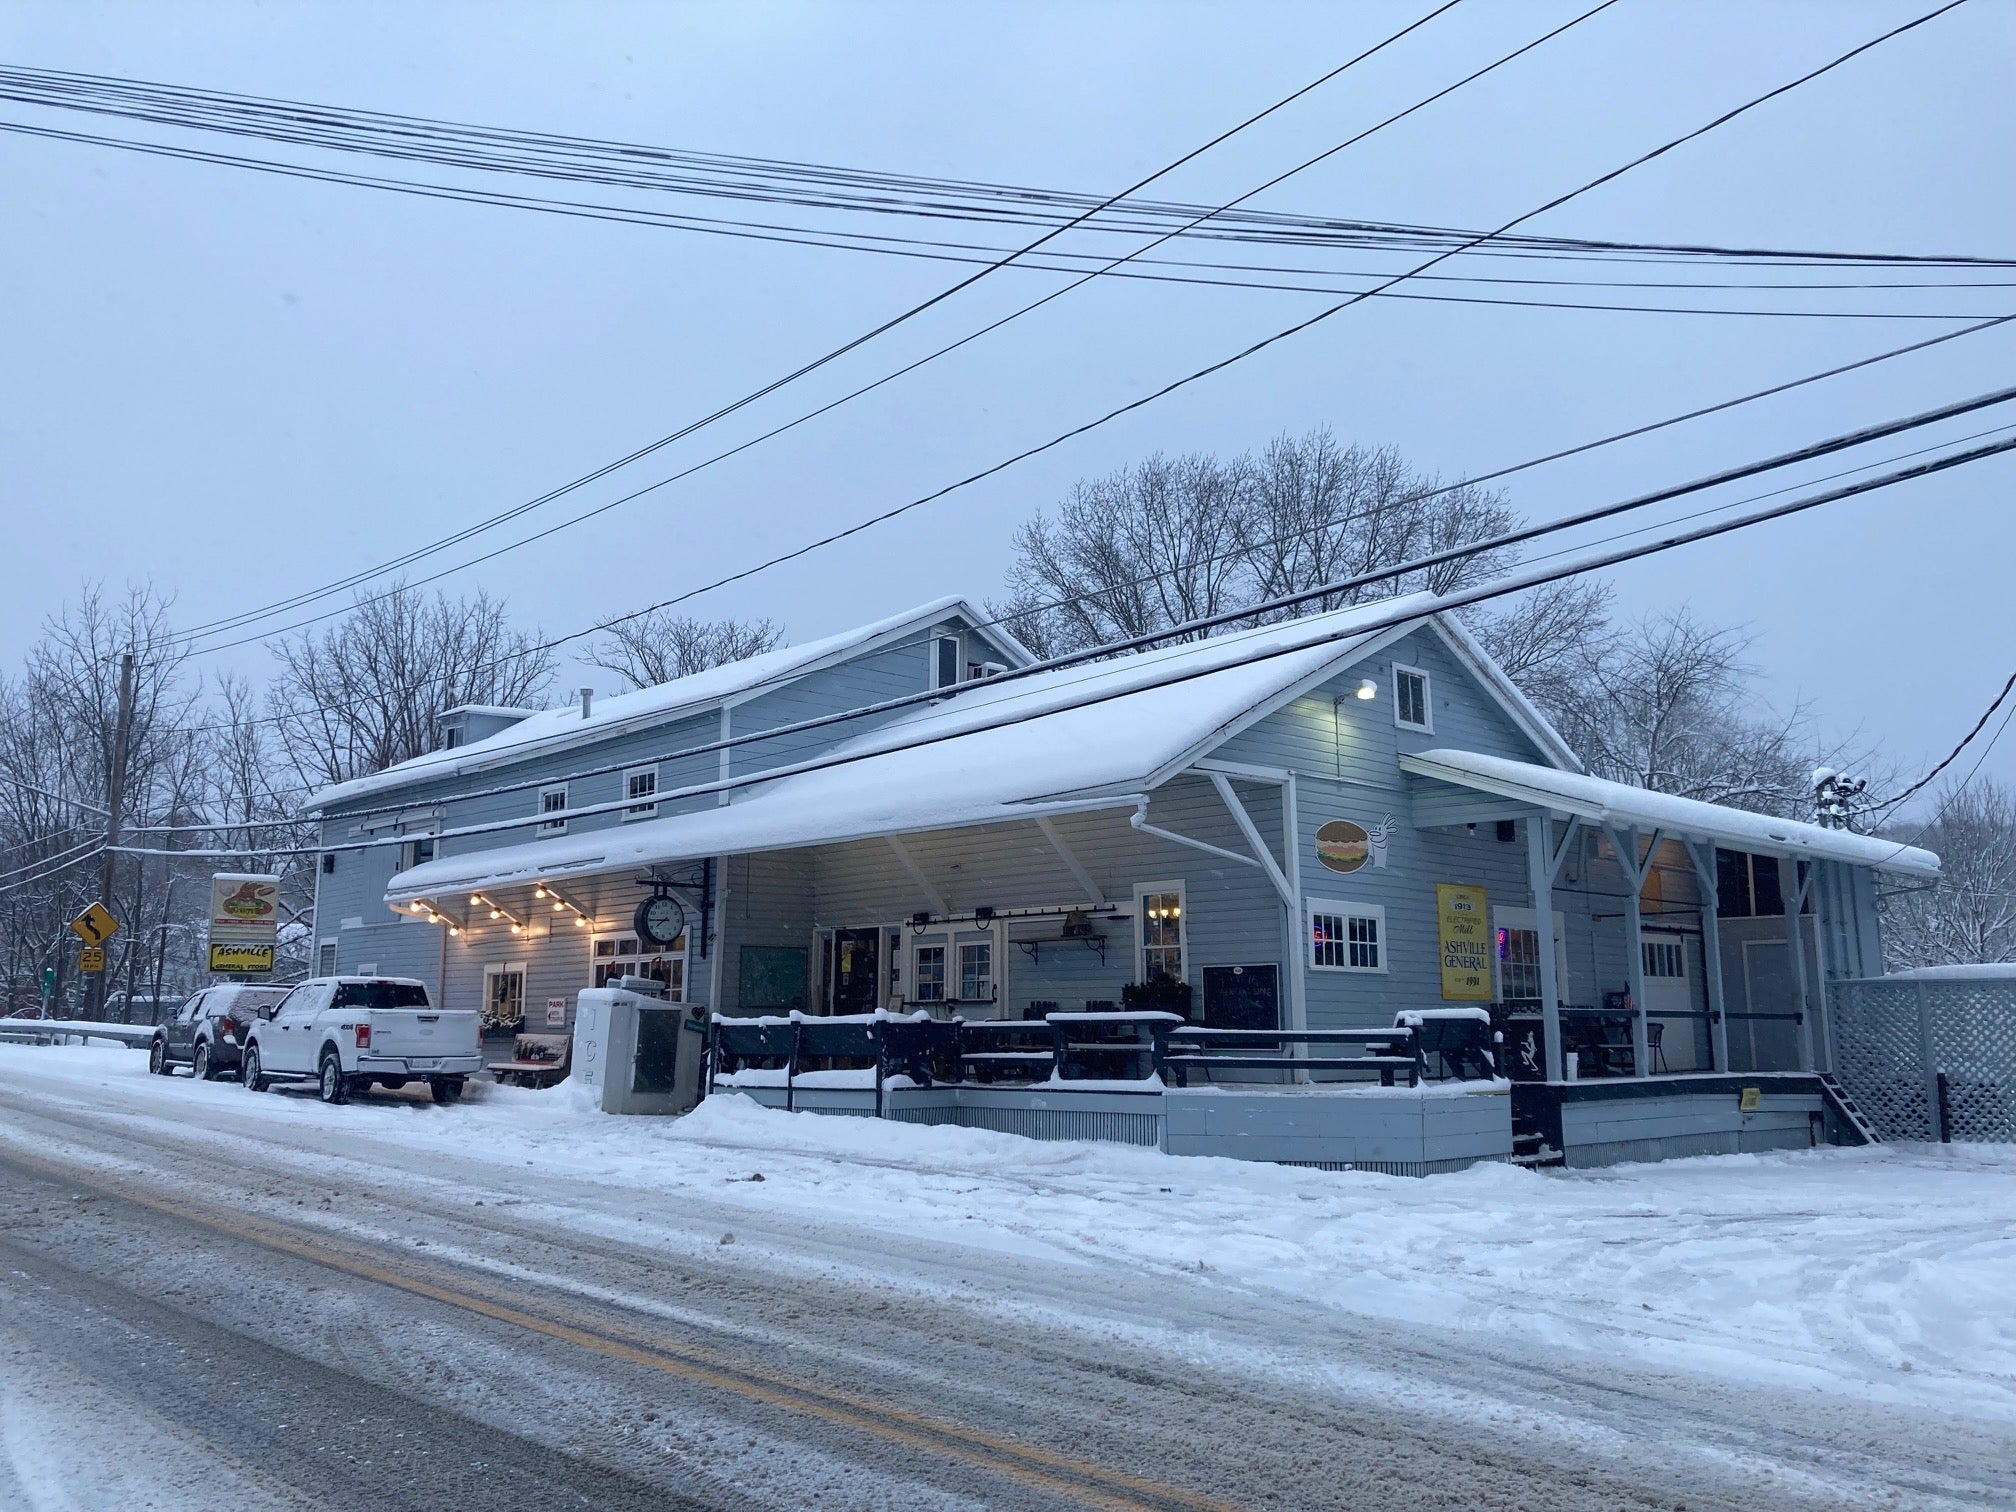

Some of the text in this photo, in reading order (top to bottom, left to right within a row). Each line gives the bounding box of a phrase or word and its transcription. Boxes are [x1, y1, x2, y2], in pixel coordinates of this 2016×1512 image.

[1454, 902, 1472, 911] 1913
[217, 947, 269, 957] ASHVILLE
[1444, 940, 1487, 956] ASHVILLE
[82, 951, 102, 962] 25
[1444, 954, 1487, 971] GENERAL
[549, 1000, 564, 1008] PARK
